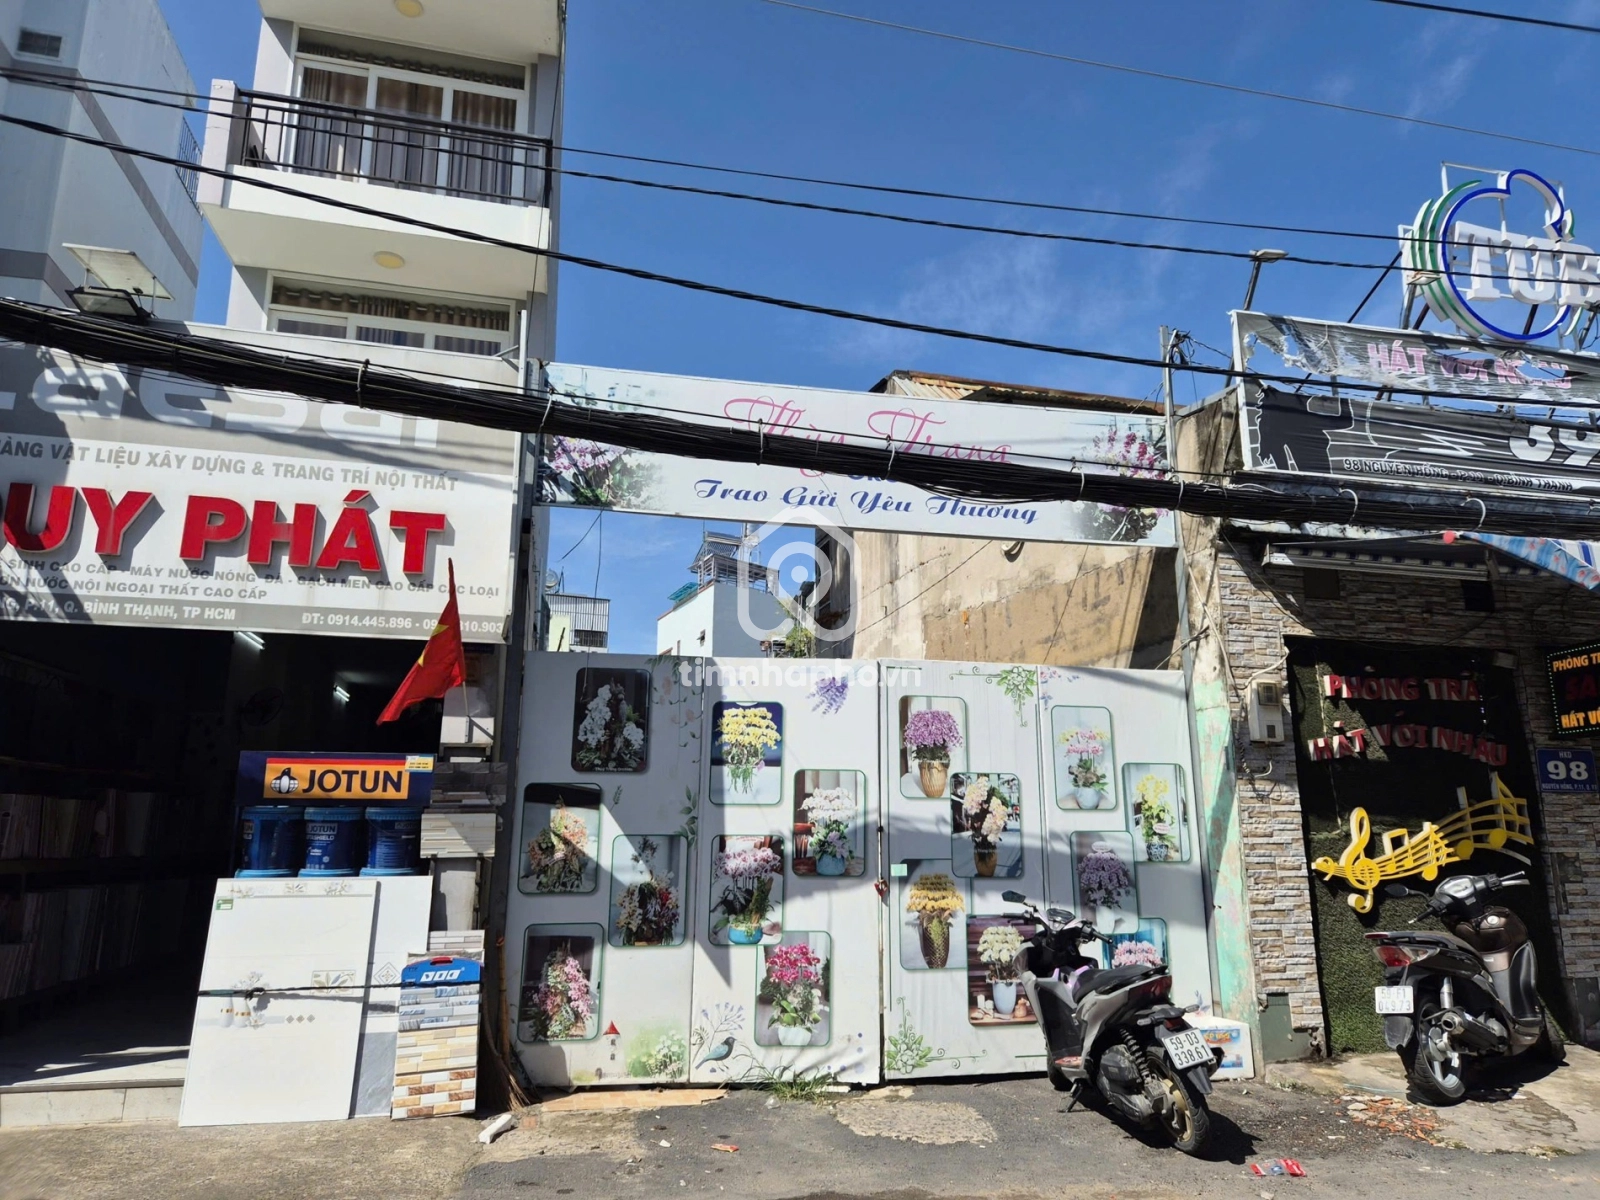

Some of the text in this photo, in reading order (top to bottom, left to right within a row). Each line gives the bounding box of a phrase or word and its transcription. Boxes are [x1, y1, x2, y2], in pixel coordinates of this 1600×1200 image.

[1367, 340, 1427, 375] HÁT
[0, 435, 459, 491] ÀNG VẬT LIỆU XÂY DỰNG & TRANG TRÍ NỘI THẤT
[1344, 459, 1361, 471] 98
[694, 479, 1039, 525] Trao Gửi Yêu Thương
[0, 481, 447, 576] UY PHÁT
[9, 559, 46, 571] SINH
[50, 561, 81, 573] CAO
[86, 560, 118, 575] CẤP
[130, 564, 164, 577] MÁY
[168, 566, 210, 580] NƯỚC
[214, 569, 256, 583] NÓNG
[297, 575, 337, 589] GẠCH
[341, 579, 371, 590] MEN
[375, 581, 403, 592] CAO
[407, 579, 435, 593] CẤP
[438, 583, 465, 595] CC
[469, 585, 499, 599] LOẠI
[26, 575, 69, 589] NƯỚC
[73, 579, 100, 593] NỘI
[105, 581, 154, 596] NGOẠI
[159, 581, 200, 596] THẤT
[204, 586, 234, 598] CAO
[238, 586, 267, 600] CẤP
[63, 601, 79, 613] Q.
[83, 600, 120, 615] BÌNH
[124, 603, 178, 619] THẠNH,
[182, 606, 202, 619] TP
[204, 607, 236, 620] HCM
[302, 612, 325, 625] ĐT:
[327, 614, 412, 630] 0914.445.896
[423, 618, 504, 634] 0910.903
[1553, 655, 1589, 672] PHÒNG
[1323, 665, 1421, 700] PHÒNG
[1561, 710, 1585, 729] HÁT
[1308, 720, 1367, 762] HÁT
[1432, 726, 1508, 767] NHAU
[302, 769, 404, 793] JOTUN
[1546, 760, 1589, 780] 98
[310, 825, 336, 833] JOTUN
[1169, 1031, 1200, 1051] 59-D3
[1174, 1044, 1210, 1066] 338.61
